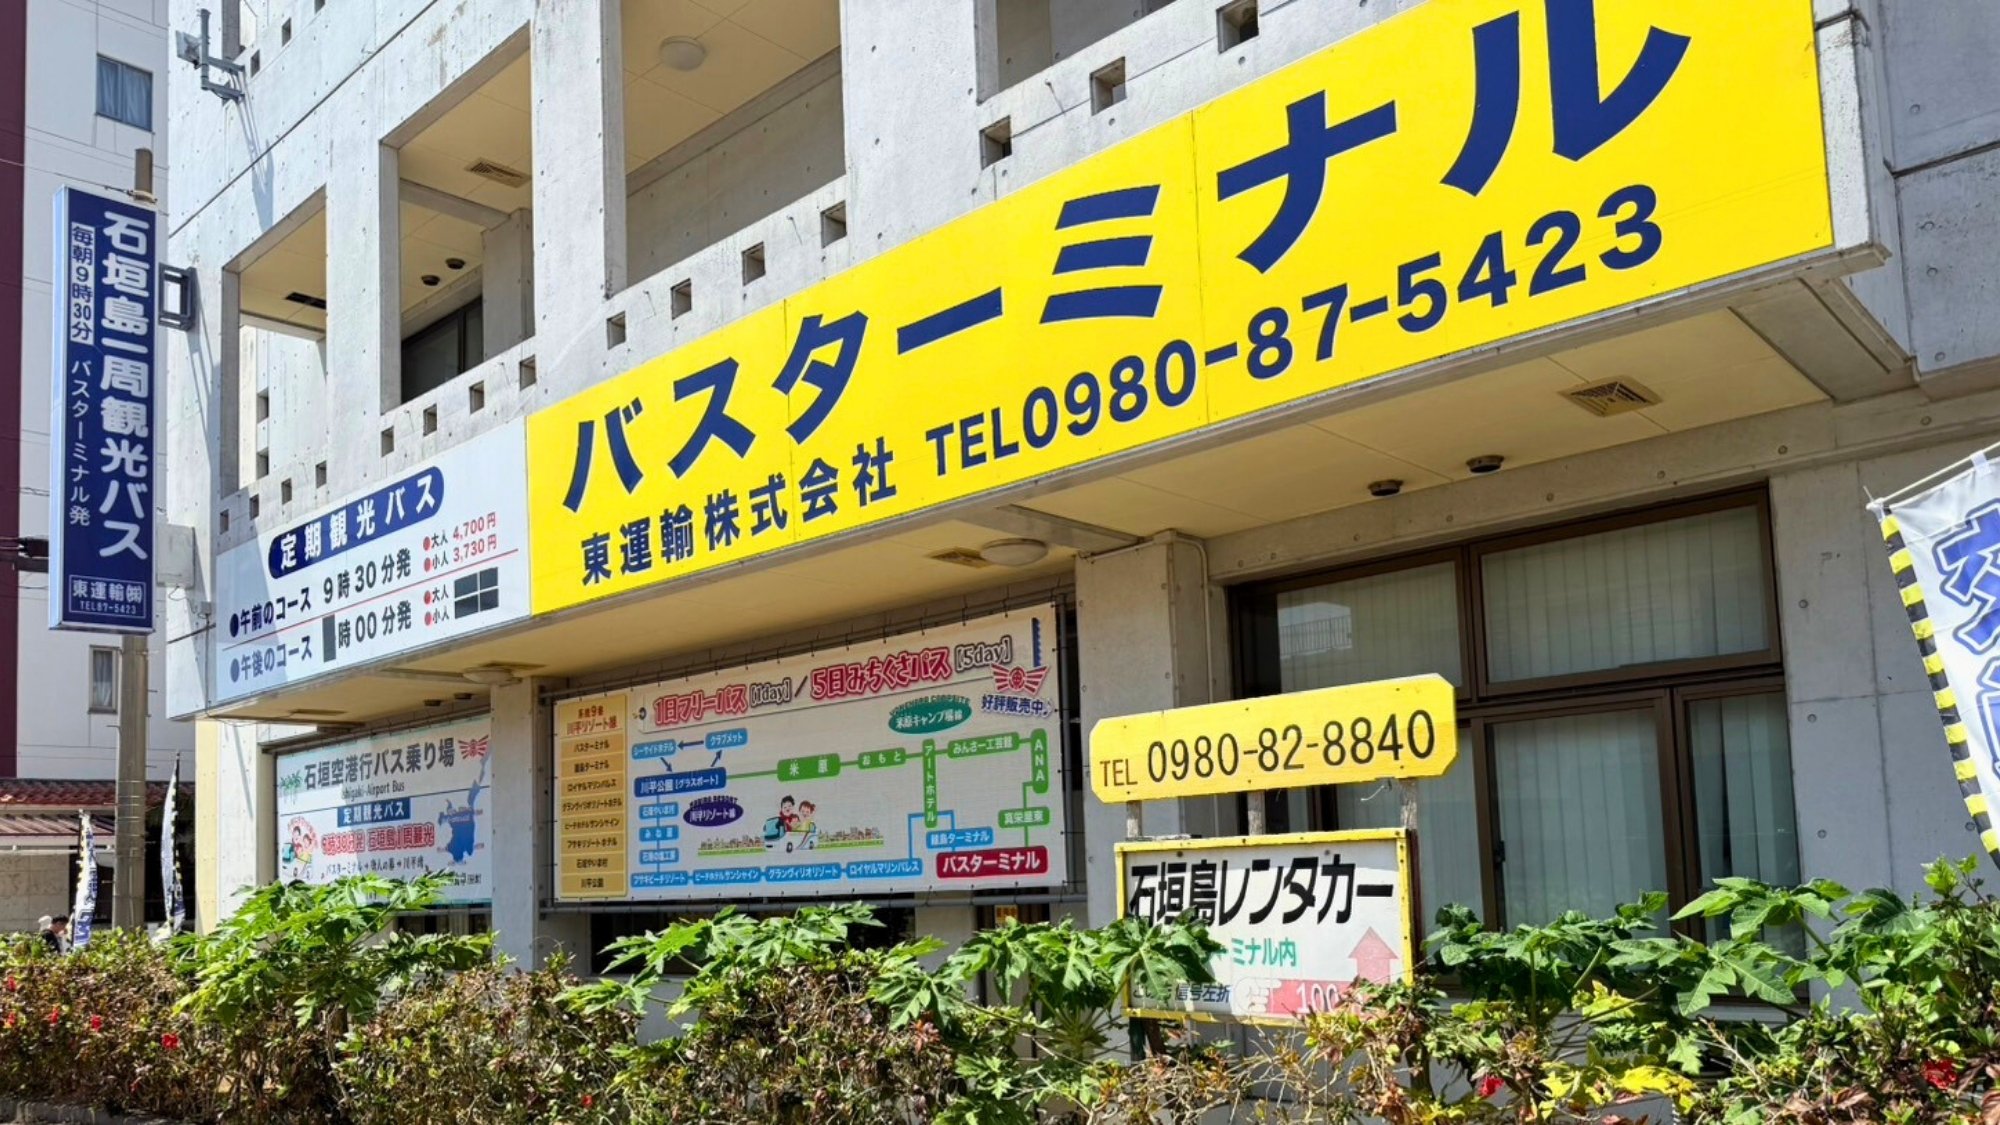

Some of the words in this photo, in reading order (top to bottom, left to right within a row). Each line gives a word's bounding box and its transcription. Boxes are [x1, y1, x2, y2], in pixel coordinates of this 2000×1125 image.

[71, 226, 94, 341] 毎朝9時30分
[563, 0, 1692, 513] バスターミナル
[99, 210, 150, 560] 石垣島一周観光バス
[69, 360, 91, 526] バスターミナル発
[279, 474, 435, 571] 定期観光バス
[452, 512, 497, 540] 4,700円
[581, 436, 897, 586] 東運輸株式会社
[240, 587, 312, 633] 午前のコース
[240, 635, 313, 683] 午後のコース
[653, 684, 749, 727] 1日フリーパス
[810, 646, 953, 700] 5日みちくさパス
[304, 737, 456, 790] 石垣空港行バス乗り場
[862, 751, 902, 766] おもと
[924, 745, 935, 822] アートホテル
[1034, 738, 1046, 782] ANA
[1100, 760, 1138, 787] TEL
[1148, 709, 1436, 783] 0980-82-8840
[343, 801, 405, 825] 定期観光バス
[942, 851, 1041, 873] バスターミナル
[1129, 854, 1395, 927] 石垣島レンタカー
